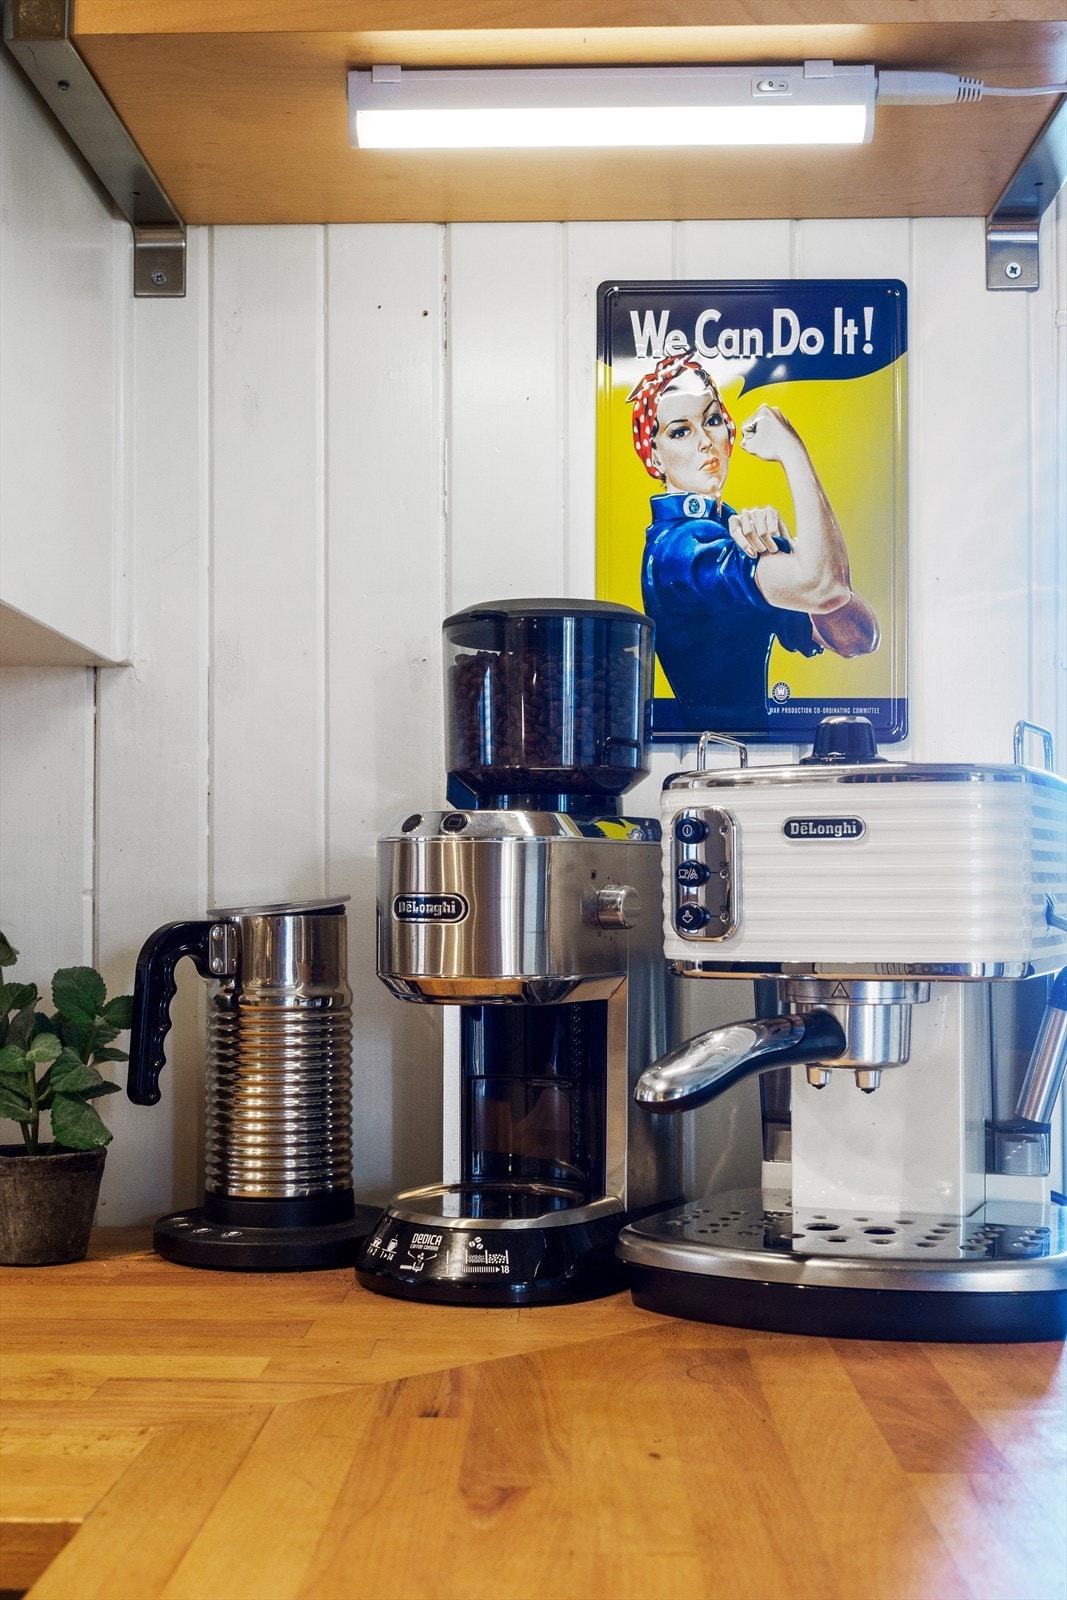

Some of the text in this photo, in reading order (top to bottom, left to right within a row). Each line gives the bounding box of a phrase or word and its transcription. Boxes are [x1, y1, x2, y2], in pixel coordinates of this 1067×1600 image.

[629, 306, 874, 359] We Can Do It!
[781, 706, 813, 714] PRODUCTION
[813, 706, 851, 715] CO-ORDINATING
[852, 706, 880, 715] COMMITTEE
[500, 1265, 510, 1274] 18
